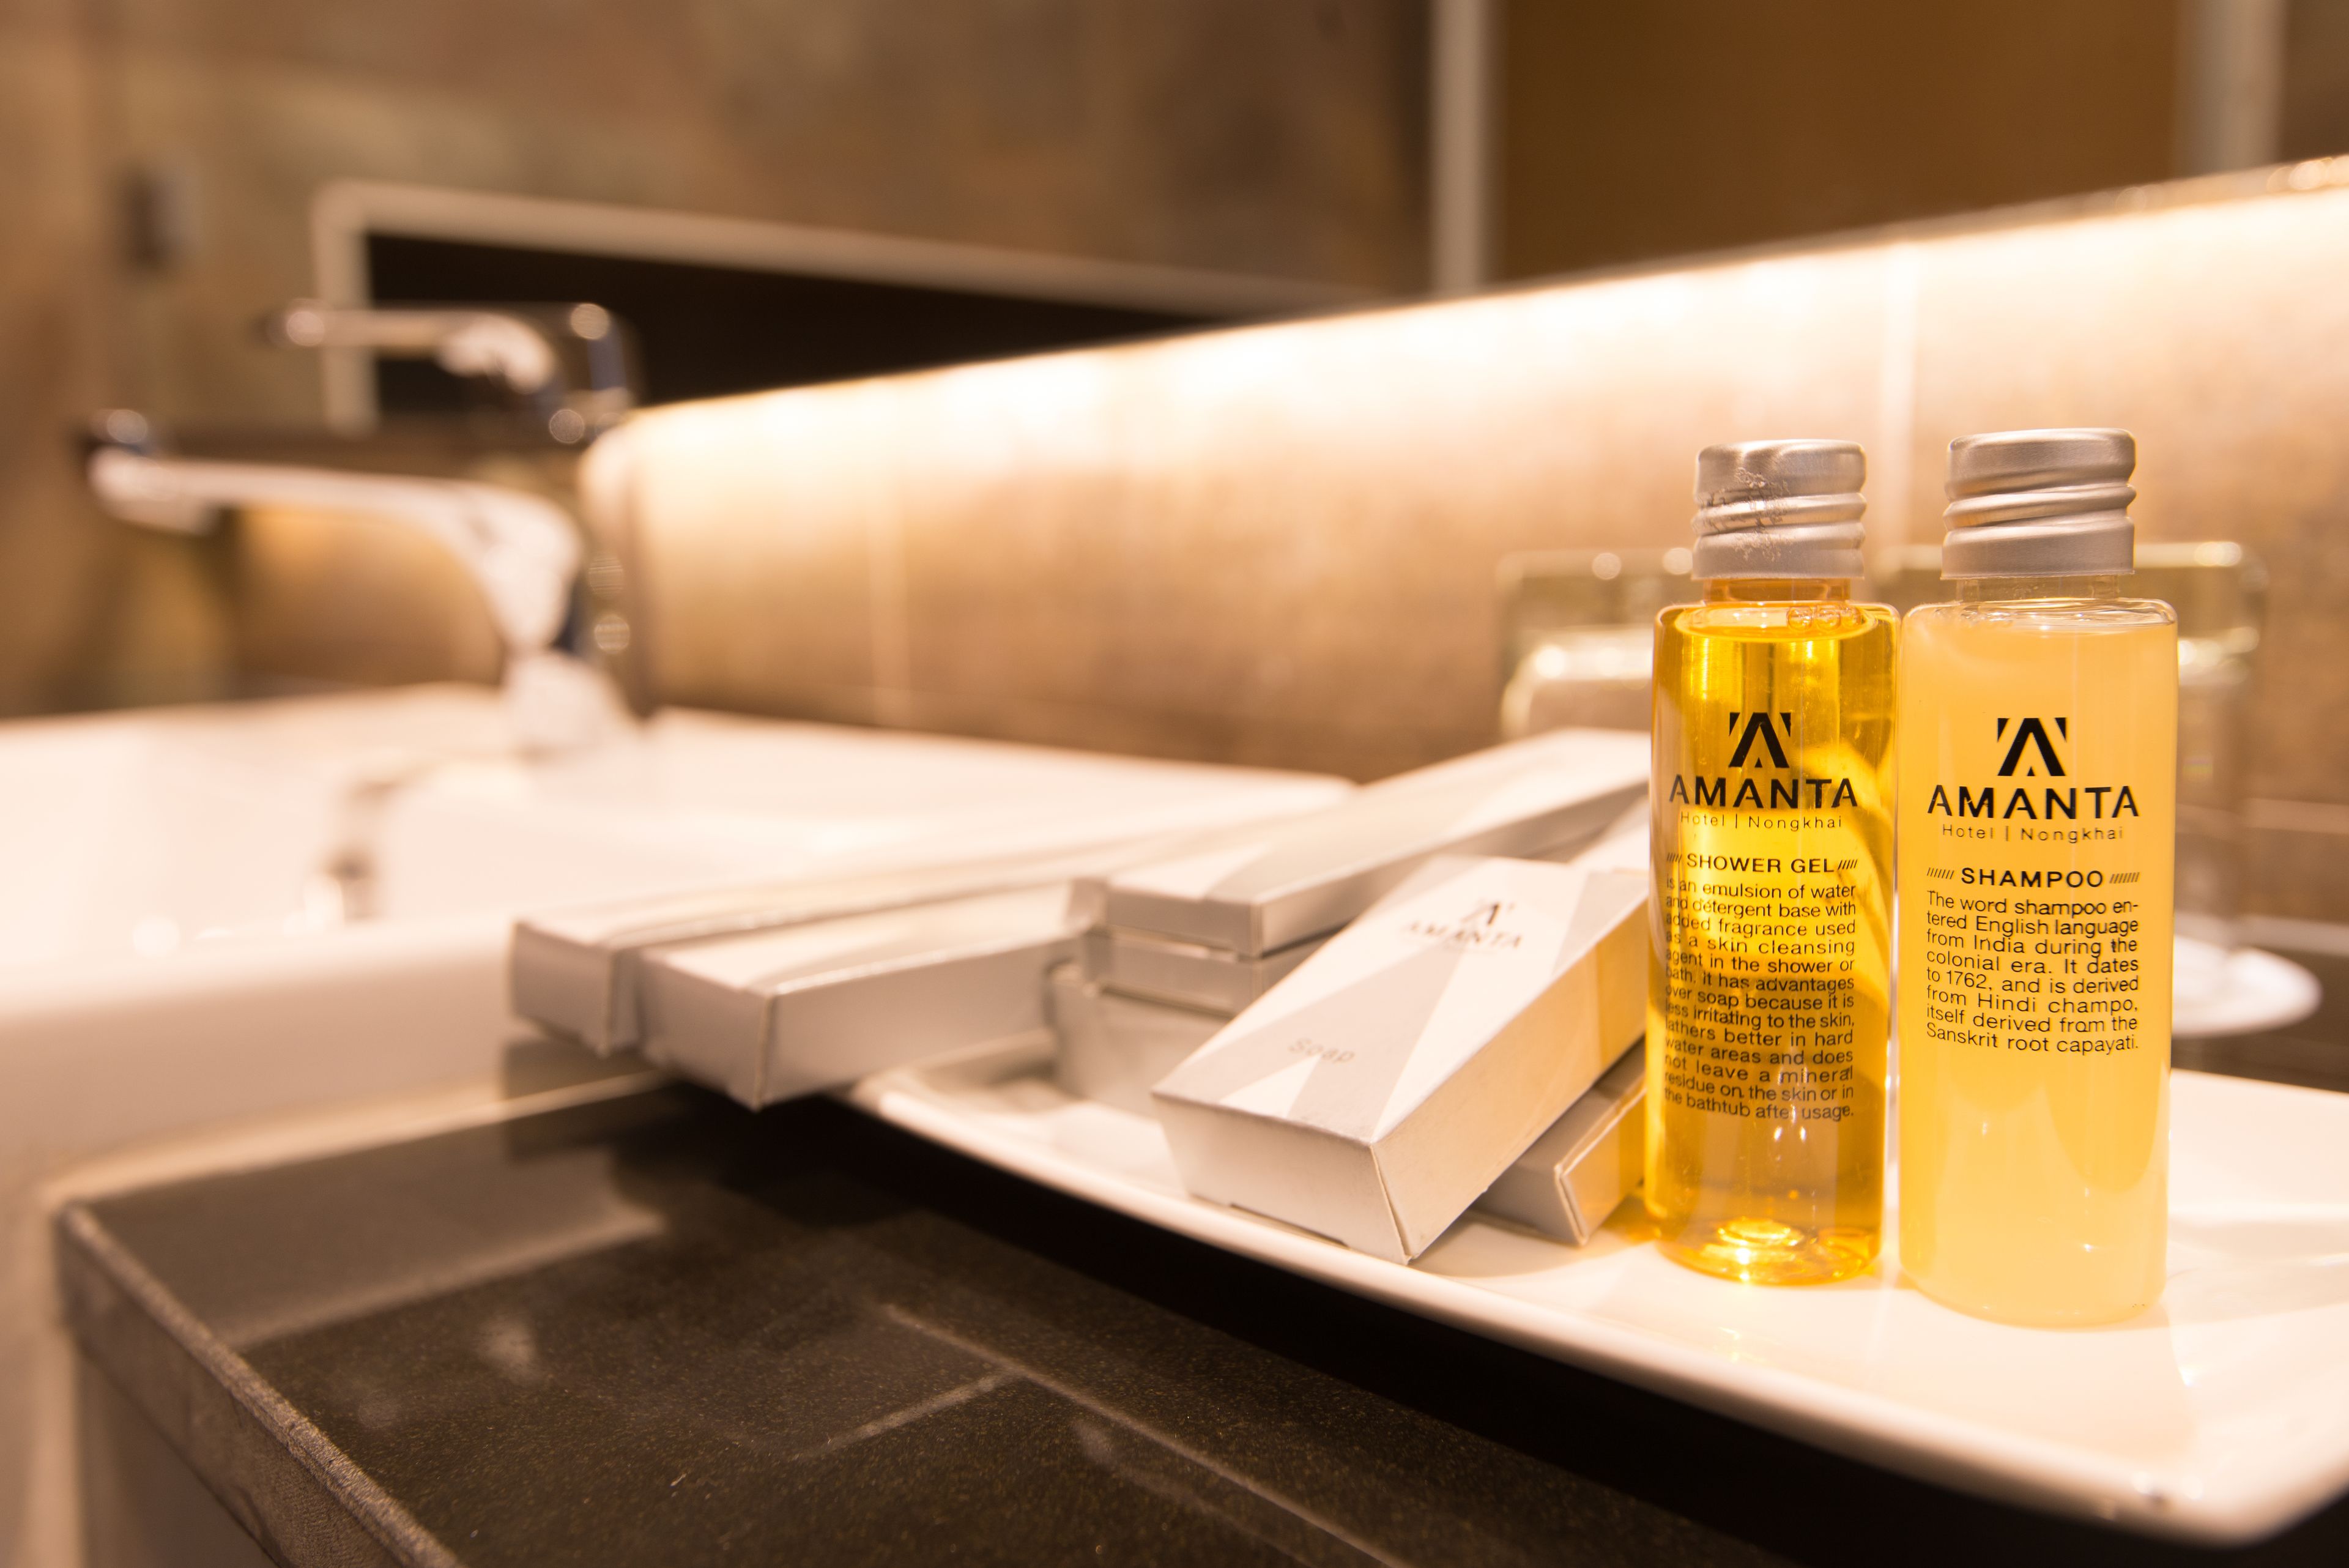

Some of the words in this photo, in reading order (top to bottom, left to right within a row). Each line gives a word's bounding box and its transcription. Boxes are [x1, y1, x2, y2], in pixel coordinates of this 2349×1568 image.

[1669, 775, 1857, 808] AMANTA
[1928, 784, 2139, 819] AMANTA
[1681, 811, 1724, 827] Hotel
[1749, 816, 1841, 831] Nongkhai
[1943, 824, 1994, 839] Hotel
[2021, 827, 2123, 844] Nongkhai
[1687, 853, 1781, 873] SHOWER
[1791, 859, 1835, 872] GEL
[1680, 880, 1696, 893] an
[1703, 883, 1781, 898] emulsion
[1788, 885, 1804, 898] of
[1811, 885, 1855, 898] water
[1961, 868, 2104, 888] SHAMPOO
[1666, 896, 1688, 909] and
[1693, 899, 1772, 918] detergent
[1779, 904, 1820, 917] base
[1825, 901, 1855, 915] with
[1928, 890, 1954, 908] The
[1960, 899, 2006, 913] word
[2015, 899, 2106, 918] shampoo
[2113, 901, 2139, 914] en-
[1666, 913, 1710, 930] added
[1719, 919, 1806, 938] fragrance
[1816, 920, 1855, 934] used
[1928, 911, 1967, 929] tered
[1976, 915, 2048, 937] English
[2055, 919, 2139, 938] language
[1666, 931, 1681, 943] as
[1689, 936, 1698, 947] a
[1708, 938, 1747, 953] skin
[1759, 941, 1854, 955] cleansing
[1928, 929, 1964, 948] from
[1975, 935, 2025, 953] India
[2035, 939, 2101, 957] during
[2111, 937, 2137, 952] the
[1666, 948, 1703, 965] agent
[1710, 953, 1723, 969] in
[1732, 956, 1759, 971] the
[1768, 959, 1833, 973] shower
[1840, 959, 1854, 971] or
[1927, 951, 1999, 971] colonial
[2011, 959, 2052, 973] era.
[2065, 959, 2077, 973] It
[2087, 956, 2139, 973] dates
[1703, 972, 1712, 985] it
[1718, 973, 1750, 988] has
[1756, 978, 1854, 993] advantages
[1928, 968, 1940, 982] to
[1946, 970, 1992, 992] 1762,
[2002, 978, 2040, 993] and
[2050, 978, 2065, 993] is
[2073, 975, 2139, 993] derived
[1666, 985, 1692, 999] over
[1698, 990, 1739, 1009] soap
[1746, 993, 1822, 1008] because
[1828, 994, 1838, 1006] it
[1842, 994, 1854, 1006] is
[1928, 985, 1966, 1006] from
[1978, 992, 2036, 1012] Hindi
[1693, 1008, 1761, 1030] irritating
[1767, 1016, 1784, 1028] to
[1788, 1016, 1816, 1028] the
[1820, 1013, 1854, 1028] skin,
[1927, 1004, 1964, 1024] itself
[1973, 1013, 2050, 1032] derived
[2060, 1017, 2104, 1032] from
[2112, 1016, 2137, 1031] the
[1724, 1028, 1781, 1046] better
[1791, 1032, 1805, 1046] in
[1815, 1030, 1852, 1046] hard
[1928, 1022, 1998, 1047] Sanskrit
[2008, 1037, 2049, 1052] root
[2057, 1035, 2138, 1055] capayati.
[1288, 1039, 1356, 1064] Soap
[1665, 1038, 1704, 1055] water
[1710, 1047, 1761, 1063] areas
[1770, 1051, 1804, 1064] and
[1813, 1050, 1853, 1064] does
[1664, 1055, 1687, 1069] not
[1696, 1060, 1748, 1080] leave
[1759, 1071, 1770, 1082] a
[1780, 1066, 1853, 1083] mineral
[1664, 1072, 1715, 1093] residue
[1749, 1085, 1776, 1099] the
[1782, 1085, 1816, 1101] skin
[1820, 1087, 1838, 1099] or
[1842, 1085, 1854, 1099] in
[1664, 1087, 1682, 1102] the
[1687, 1093, 1750, 1117] bathtub
[1756, 1103, 1796, 1118] afte
[1802, 1104, 1854, 1122] usage.
